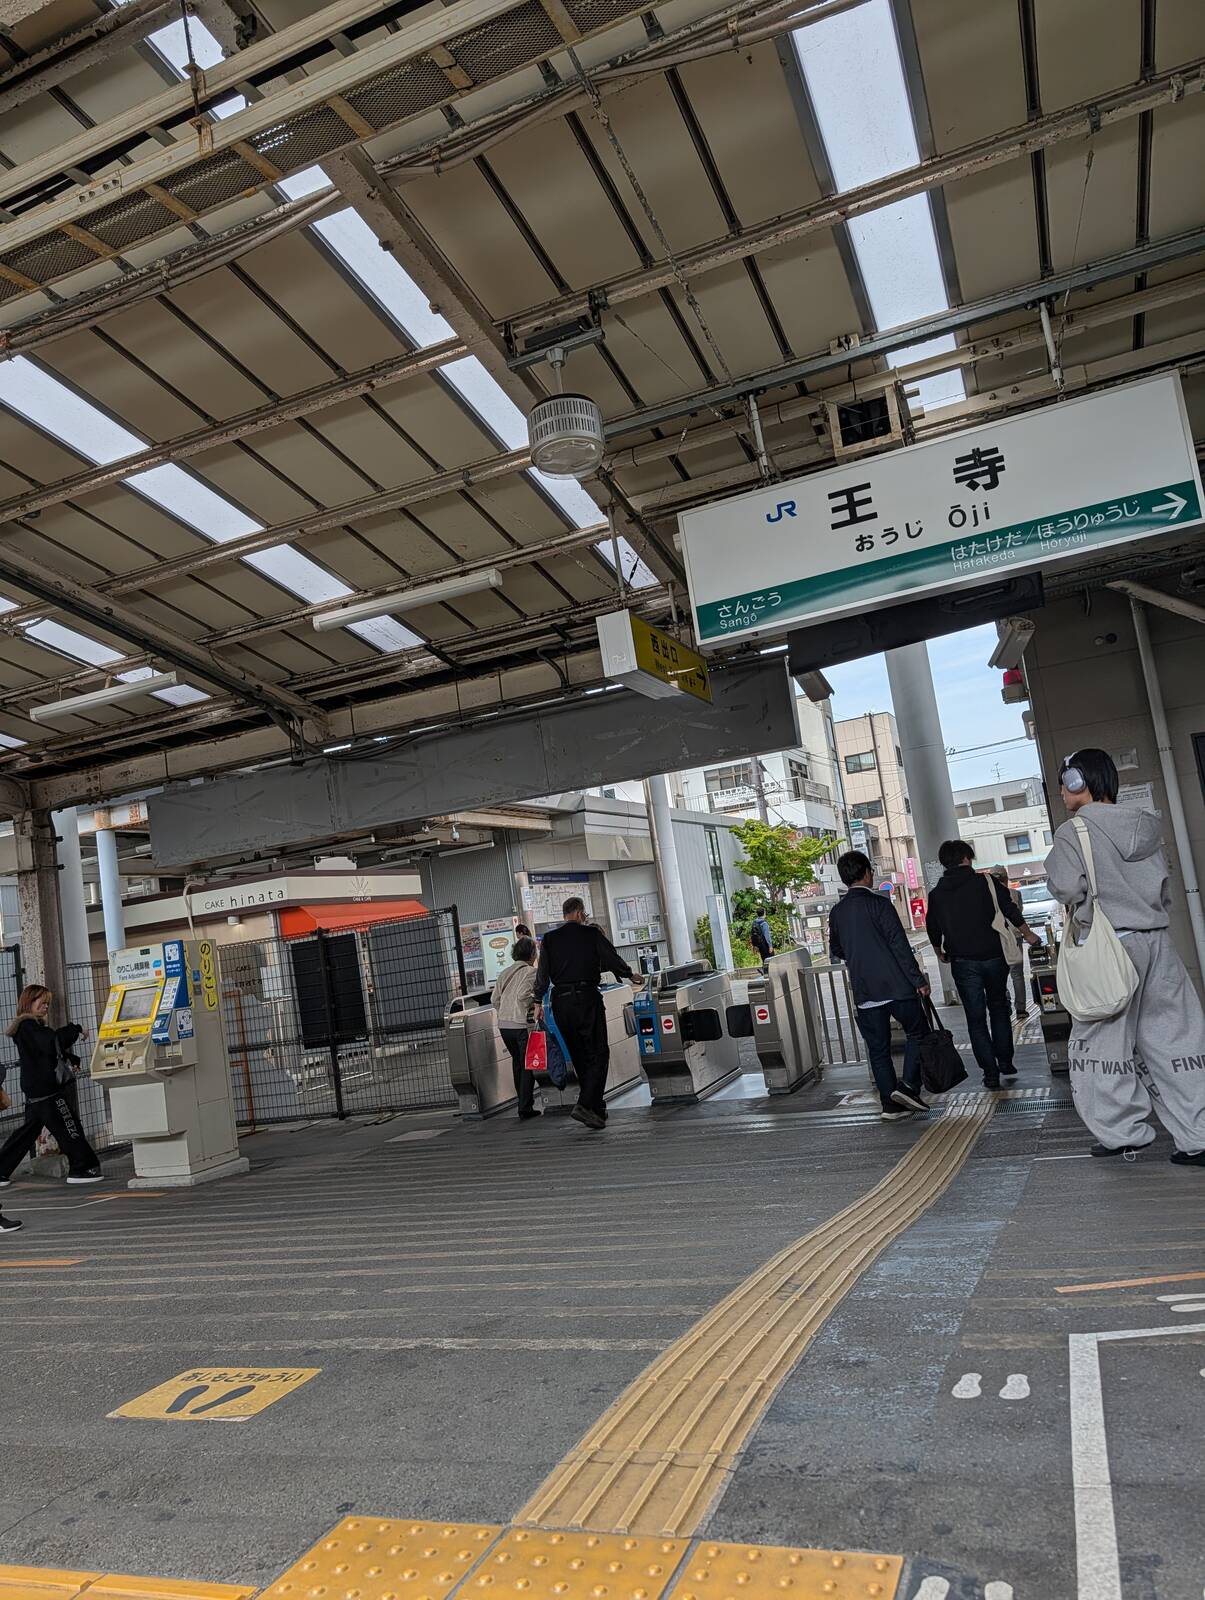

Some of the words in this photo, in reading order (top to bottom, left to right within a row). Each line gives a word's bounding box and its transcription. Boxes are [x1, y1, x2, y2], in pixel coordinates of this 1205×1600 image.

[765, 500, 798, 523] JR
[855, 519, 924, 553] おうじ
[952, 548, 1016, 574] Hatakeda
[717, 591, 783, 619] さんごう
[204, 899, 225, 910] CAKE
[230, 889, 285, 908] hinata
[200, 943, 216, 1008] のりこし
